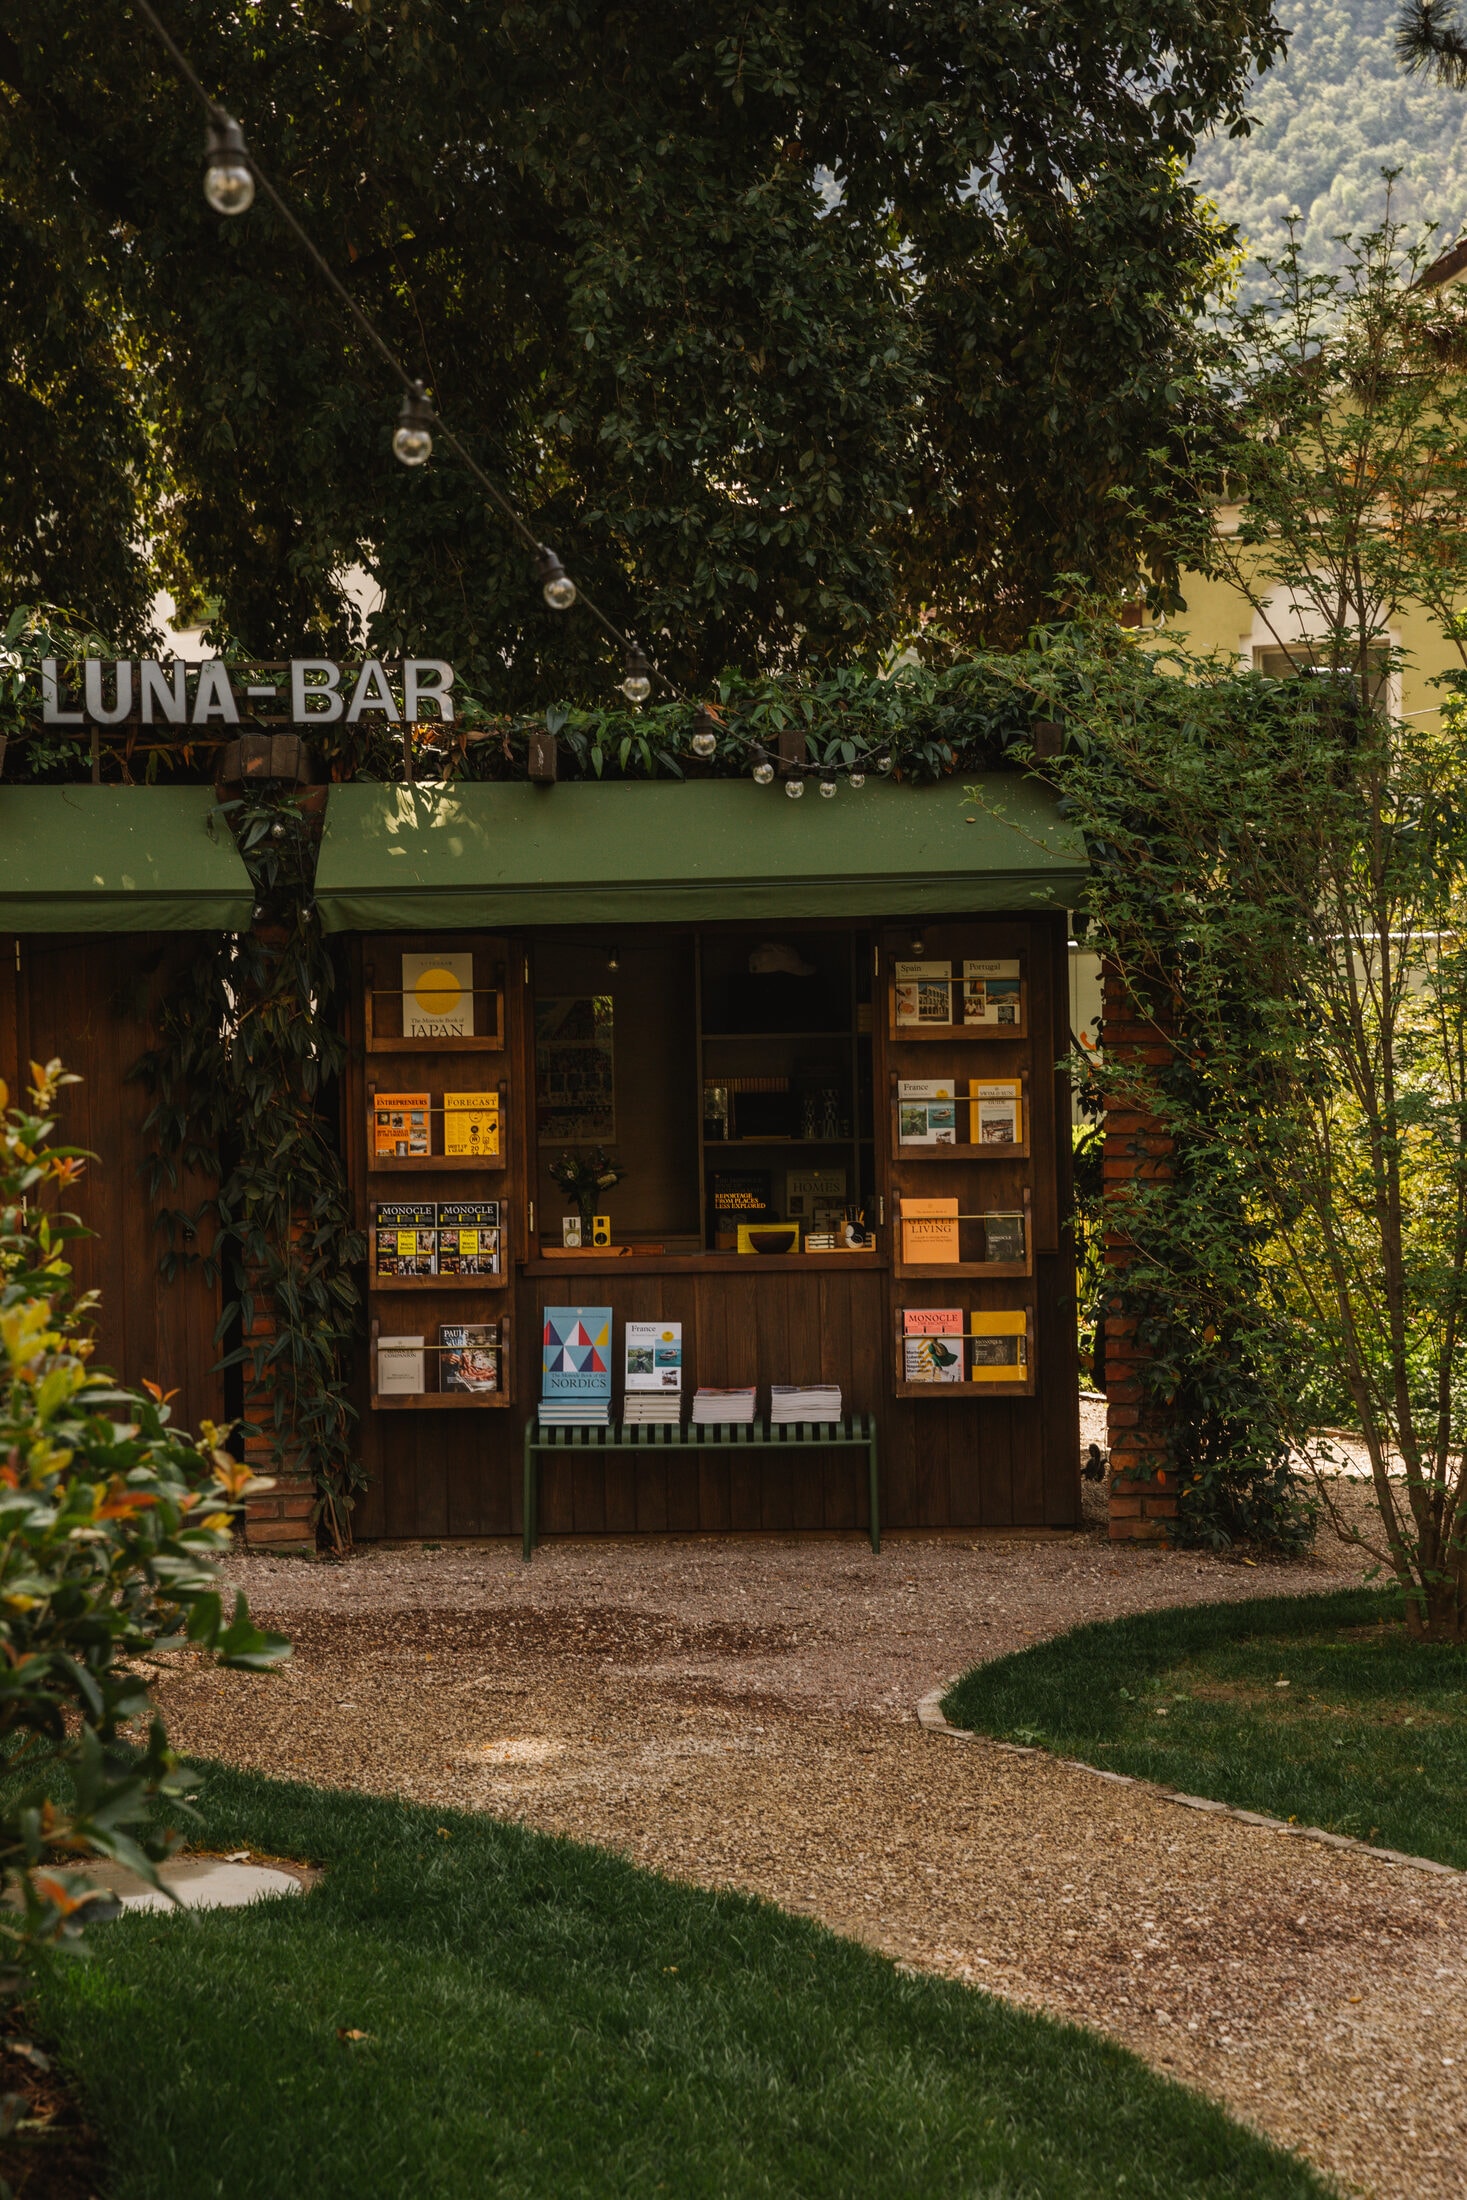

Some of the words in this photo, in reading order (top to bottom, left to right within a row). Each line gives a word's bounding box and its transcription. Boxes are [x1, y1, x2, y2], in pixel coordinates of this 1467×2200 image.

[42, 659, 455, 724] LUNA-BAR
[901, 965, 921, 973] Spain
[969, 963, 1001, 972] Portugal
[411, 1024, 464, 1038] JAPAN
[903, 1083, 929, 1091] France
[792, 1182, 842, 1194] HOMES
[382, 1207, 432, 1215] MONOCLE
[444, 1206, 494, 1214] MONOCLE
[911, 1225, 952, 1234] LIVING
[909, 1314, 958, 1322] MONOCLE
[631, 1325, 657, 1333] France
[551, 1379, 607, 1389] NORDICS
